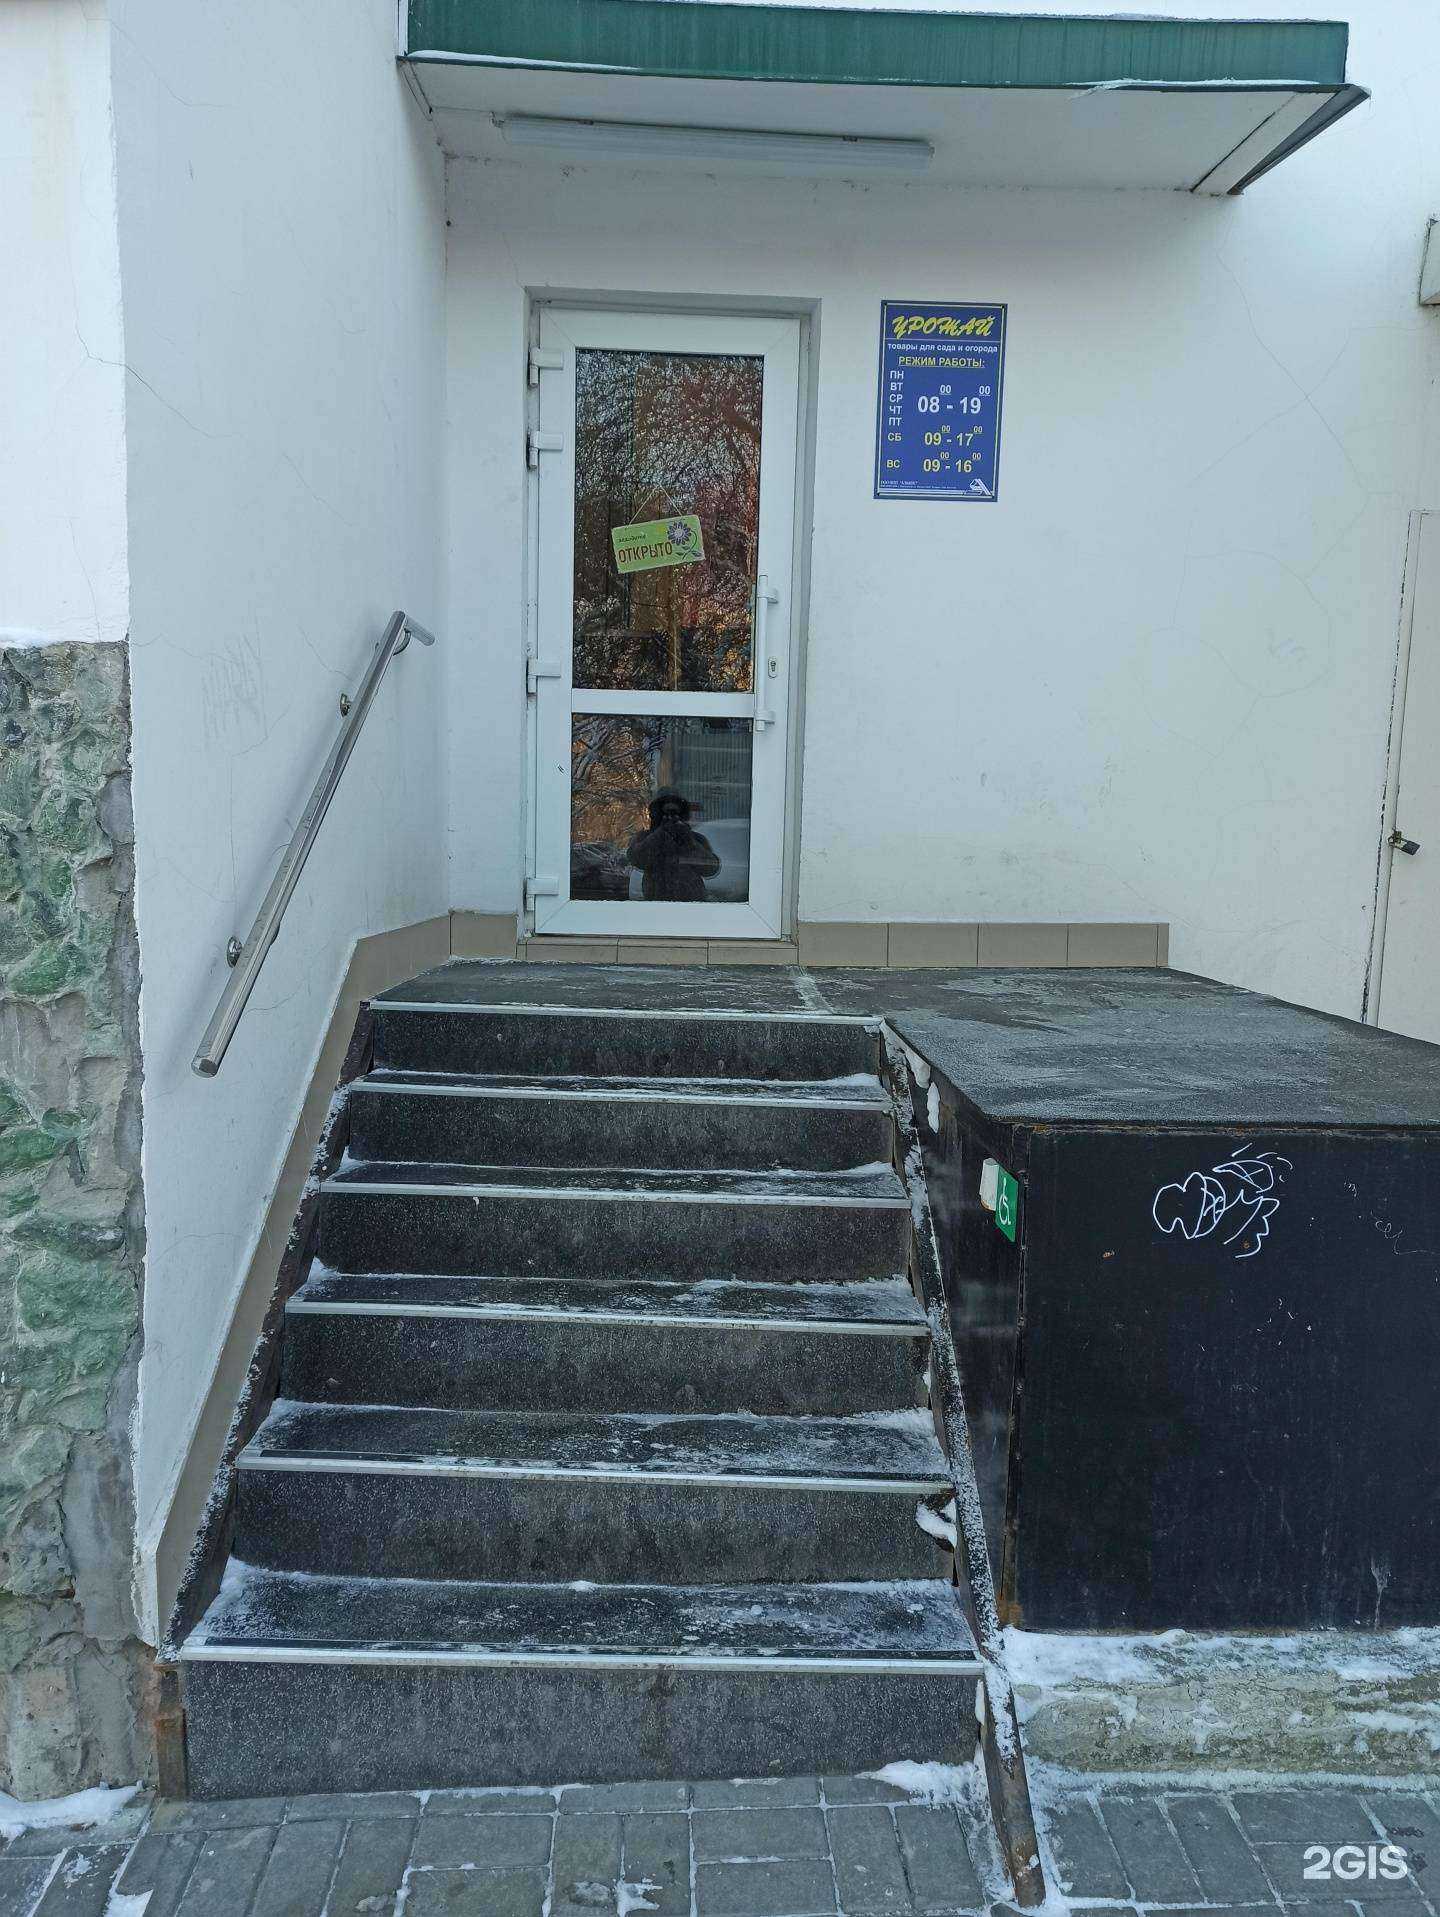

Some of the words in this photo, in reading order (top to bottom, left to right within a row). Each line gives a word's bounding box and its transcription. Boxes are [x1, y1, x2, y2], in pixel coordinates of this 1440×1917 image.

[892, 315, 996, 340] УРОЖАЙ
[888, 343, 918, 352] товары
[920, 344, 935, 352] для
[937, 344, 956, 352] сада
[965, 345, 998, 354] огорода
[899, 357, 936, 366] РЕЖИМ
[939, 357, 986, 368] РАБОТЫ:
[889, 371, 905, 379] ПН
[890, 383, 903, 391] ВТ
[889, 394, 903, 402] СР
[889, 406, 902, 414] ЧТ
[918, 396, 940, 413] 08
[960, 397, 981, 414] 19
[888, 417, 902, 426] ПТ
[888, 433, 902, 441] СБ
[924, 432, 941, 445] 09
[956, 433, 973, 446] 17
[886, 460, 900, 468] ВС
[923, 459, 940, 472] 09
[955, 460, 972, 473] 16
[618, 542, 672, 563] ОТКРЫТО
